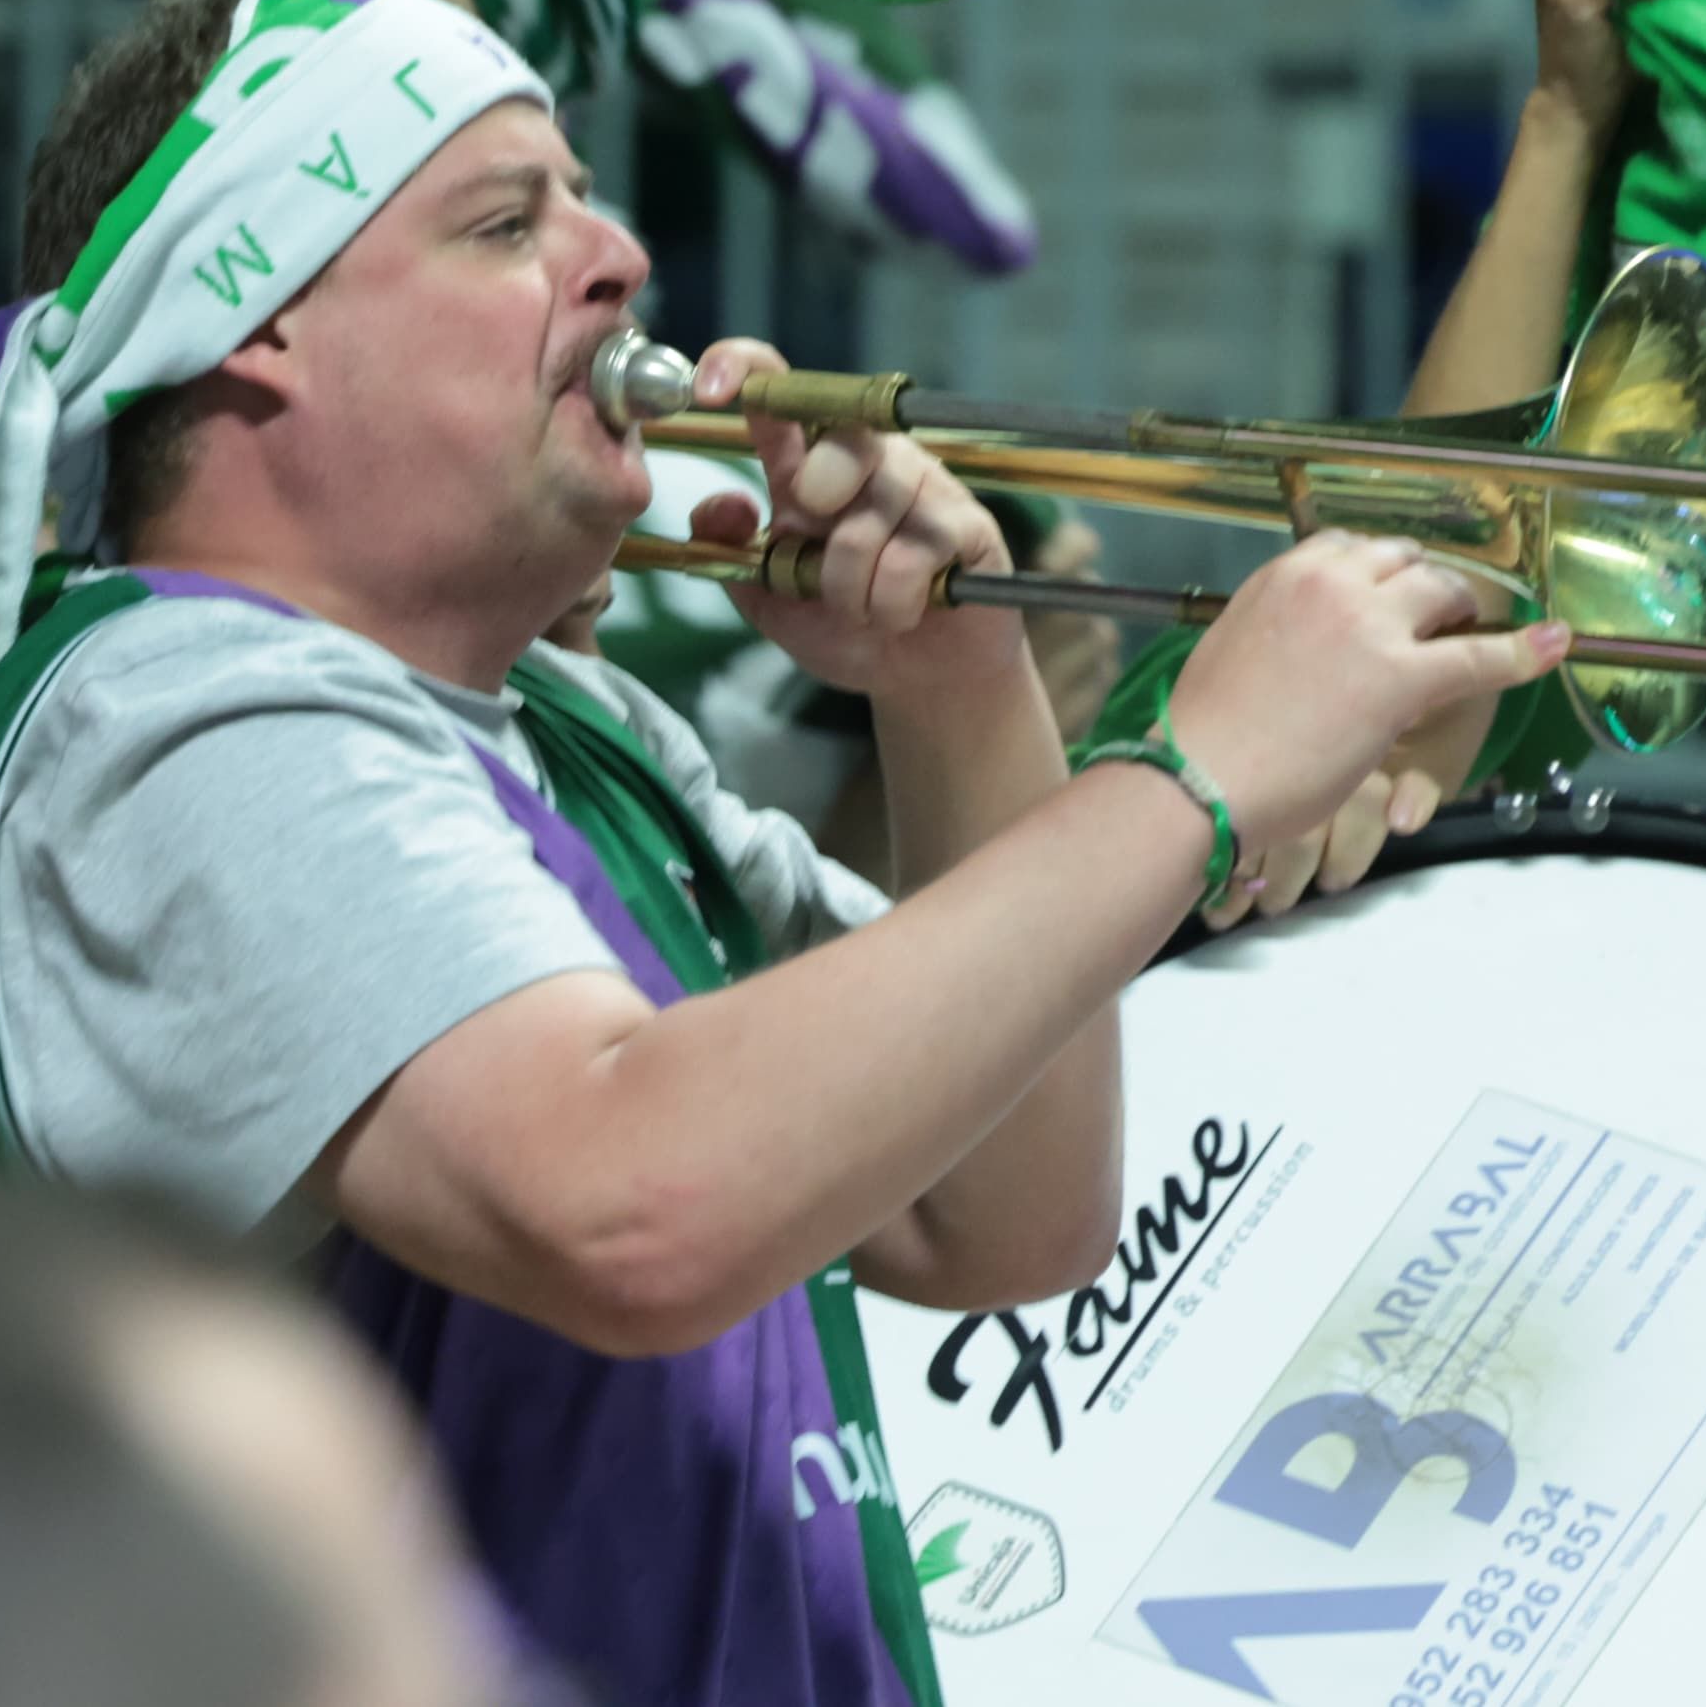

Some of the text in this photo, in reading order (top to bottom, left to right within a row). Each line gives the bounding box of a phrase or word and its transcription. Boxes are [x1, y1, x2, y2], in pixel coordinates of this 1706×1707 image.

[926, 1117, 1249, 1453] Fame
[1104, 1139, 1315, 1414] drums & percussion
[1358, 1133, 1547, 1366] ARRABAL
[1444, 1562, 1519, 1640] 283
[1502, 1481, 1576, 1558] 334
[1489, 1579, 1563, 1656] 926
[1545, 1500, 1619, 1576] 851
